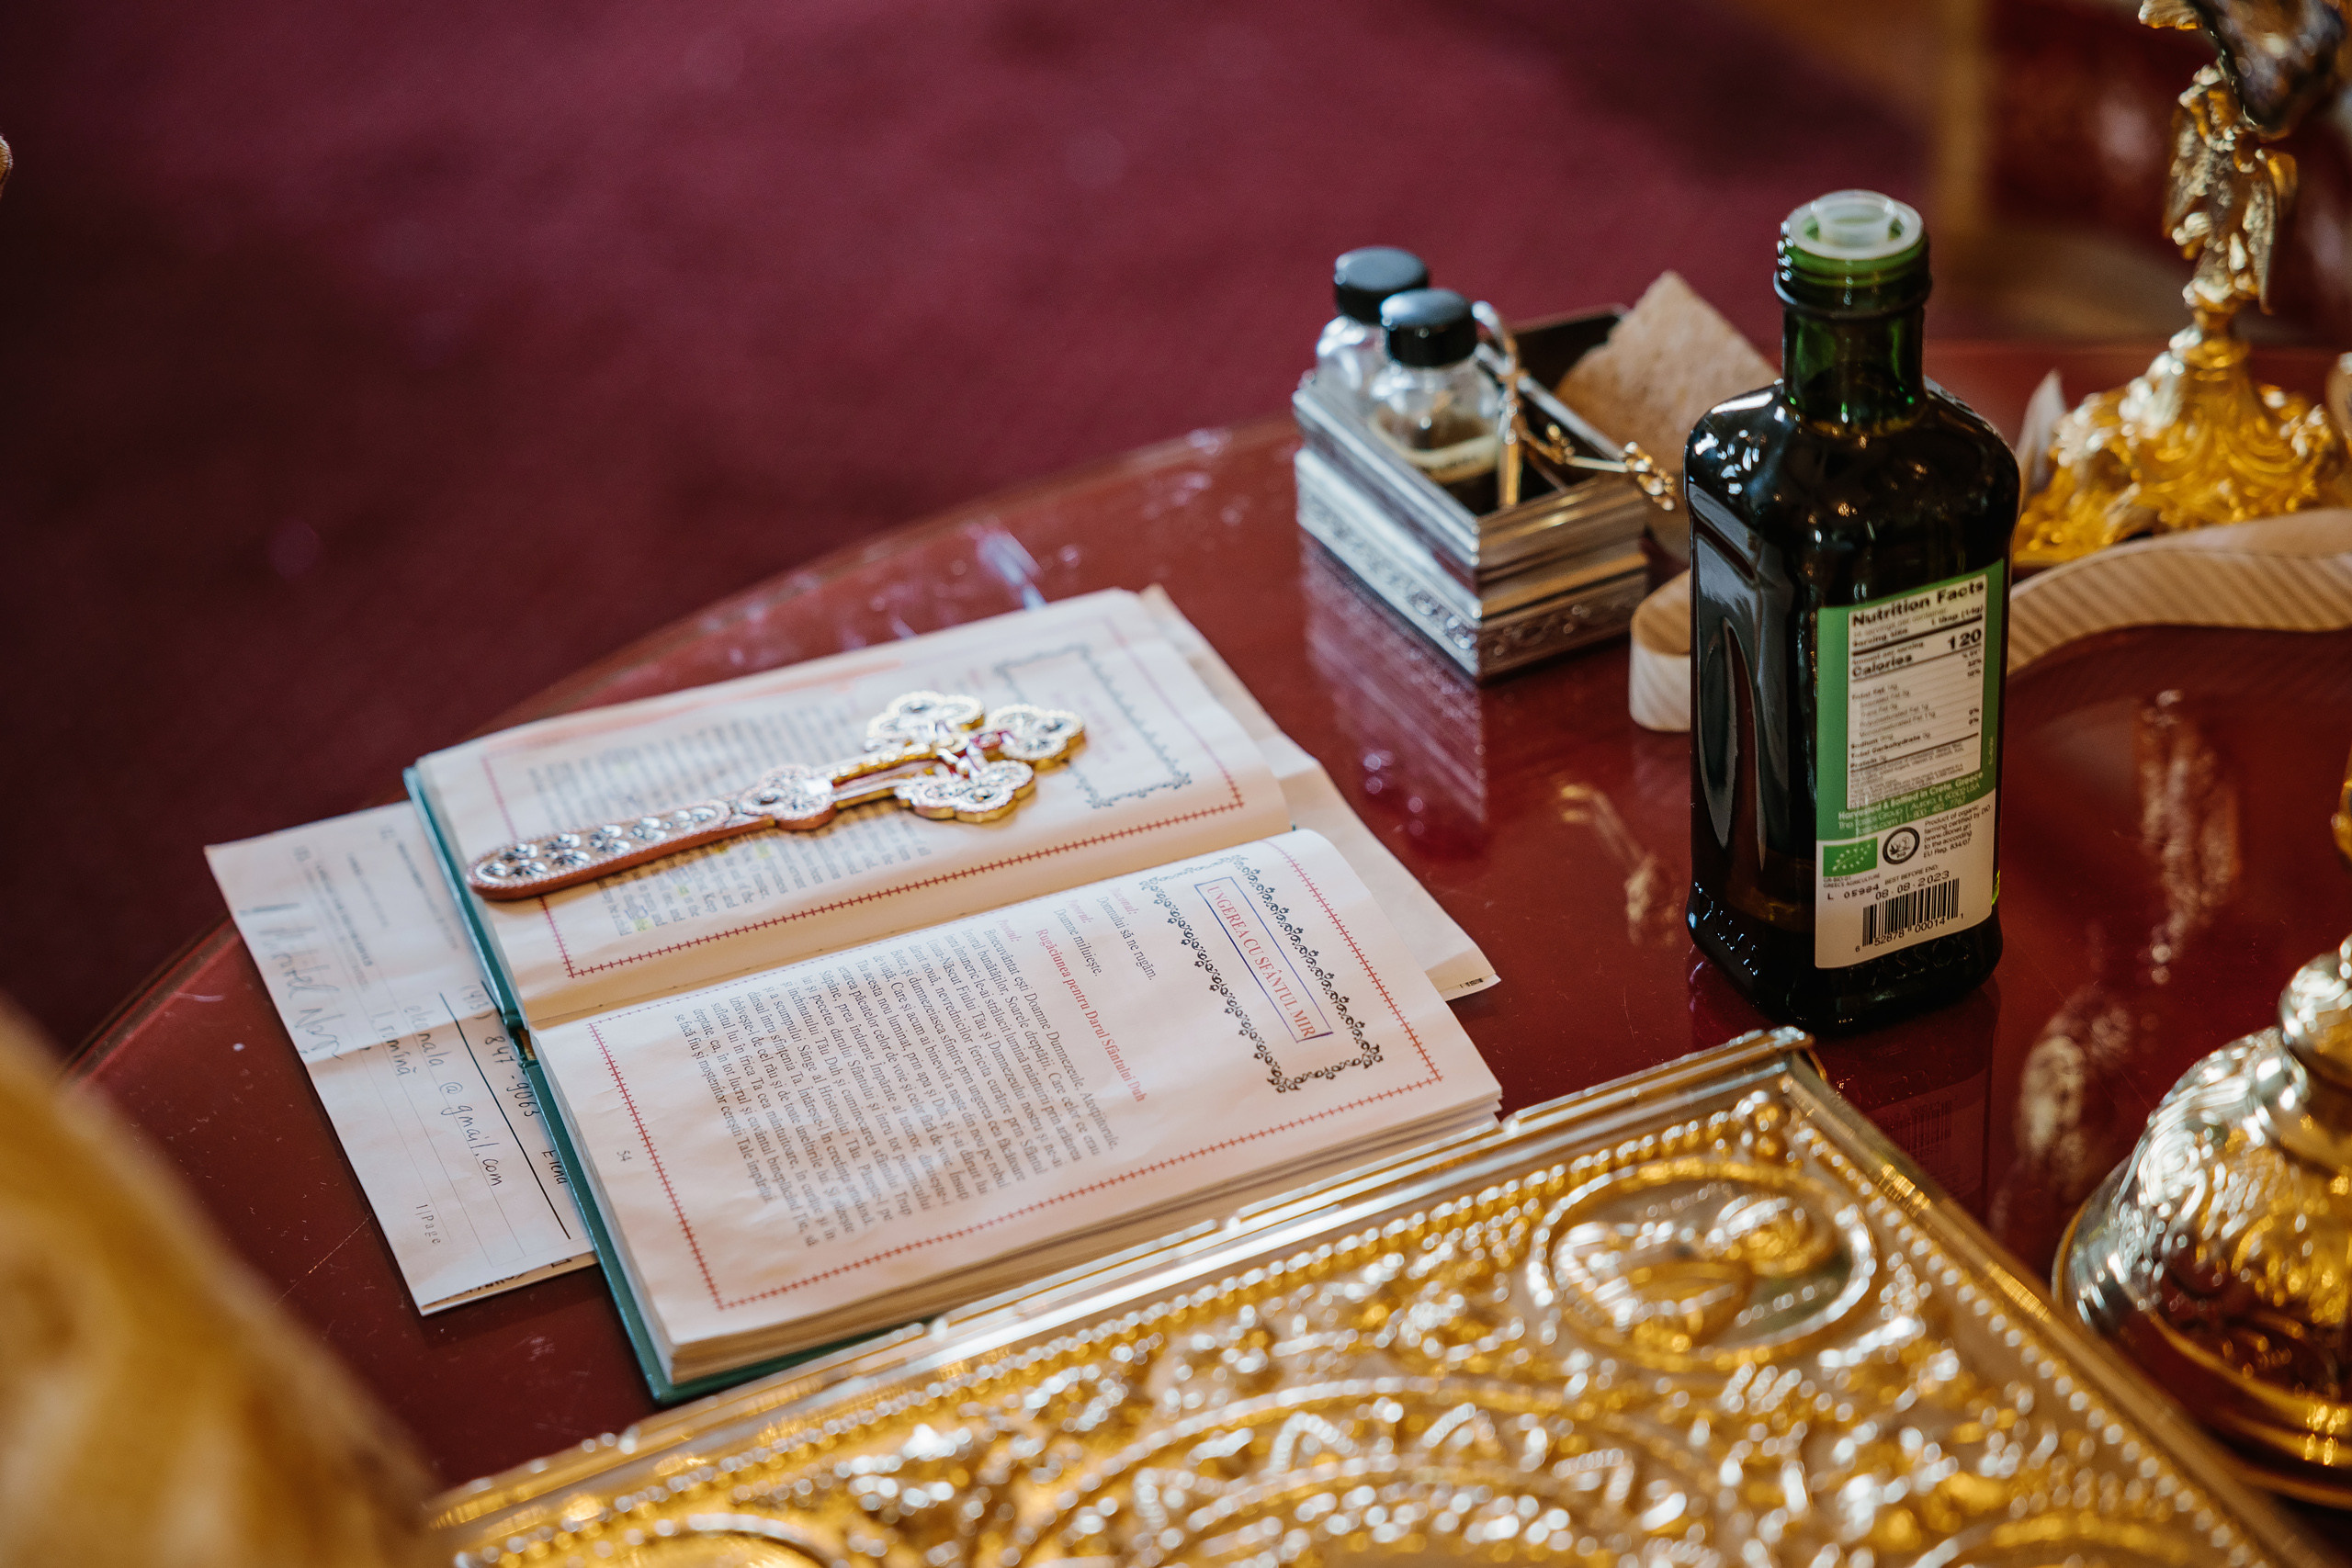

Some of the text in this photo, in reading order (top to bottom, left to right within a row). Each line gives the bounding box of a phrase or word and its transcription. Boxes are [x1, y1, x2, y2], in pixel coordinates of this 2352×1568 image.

[1852, 581, 1984, 626] Nutrition Facts
[1852, 628, 1982, 678] Calories 120
[1924, 815, 1950, 828] Product
[1950, 811, 1957, 820] of
[1957, 805, 1980, 818] organic
[1924, 823, 1947, 835] farming
[1948, 815, 1973, 829] certified
[1942, 830, 1973, 846] according
[1923, 850, 1932, 859] EU
[1884, 876, 1900, 886] BEST
[1901, 869, 1924, 881] BEFORE
[1826, 892, 1834, 900] L
[1118, 928, 1135, 940] să
[1125, 939, 1140, 951] ne
[1873, 929, 1905, 947] 52878
[1914, 917, 1946, 933] 00014
[952, 946, 984, 980] întuneric
[1205, 885, 1318, 1037] UNGEREA CU SFÂNTUL MIR
[861, 971, 886, 997] acesta
[973, 978, 994, 998] le-ai
[876, 998, 893, 1014] nou
[983, 998, 1013, 1032] strălucit
[1032, 928, 1075, 978] Rugăciunea
[1061, 977, 1094, 1010] pentru
[1083, 1010, 1111, 1039] Darul
[1099, 1038, 1137, 1082] Sfântului
[678, 1021, 697, 1037] facă
[759, 1014, 780, 1033] întru
[769, 998, 806, 1043] scumpului
[686, 1036, 704, 1050] fiu
[725, 1029, 742, 1043] lui
[731, 1043, 748, 1054] în
[848, 988, 911, 1083] păcatelor celor de voie
[907, 976, 950, 1034] dumnezeiasca
[963, 1084, 994, 1121] ungerea
[955, 985, 1030, 1100] Fiului Tău Dumnezeului
[1003, 995, 1034, 1029] Soarele
[1046, 1071, 1070, 1094] Care
[1003, 1032, 1031, 1064] lumină
[484, 1034, 515, 1066] 847
[716, 1053, 730, 1062] în
[793, 1043, 821, 1073] Sânge
[834, 1002, 907, 1114] prea îndurate Împărate al
[902, 1050, 926, 1071] prin
[933, 986, 977, 1043] nevrednicilor
[967, 1044, 996, 1077] fericita
[1002, 1115, 1028, 1138] prin
[720, 1062, 737, 1076] tot
[738, 1054, 760, 1077] frica
[786, 987, 823, 1035] închinatului
[813, 1036, 833, 1055] Tău
[841, 1088, 881, 1147] cuminecarea
[808, 993, 904, 1152] pecetea darului Sfântului întru tot
[810, 1072, 827, 1084] al
[889, 980, 994, 1162] Care acum binevoit din nou pe
[728, 1076, 752, 1104] lucrul
[749, 1077, 766, 1091] Ta
[912, 1071, 932, 1089] apa
[750, 1035, 826, 1168] de cel rău toate uneltirile
[817, 1084, 854, 1136] Hristosului
[745, 1114, 776, 1155] cuvântul
[616, 1149, 632, 1162] 54
[735, 1136, 757, 1160] Tale
